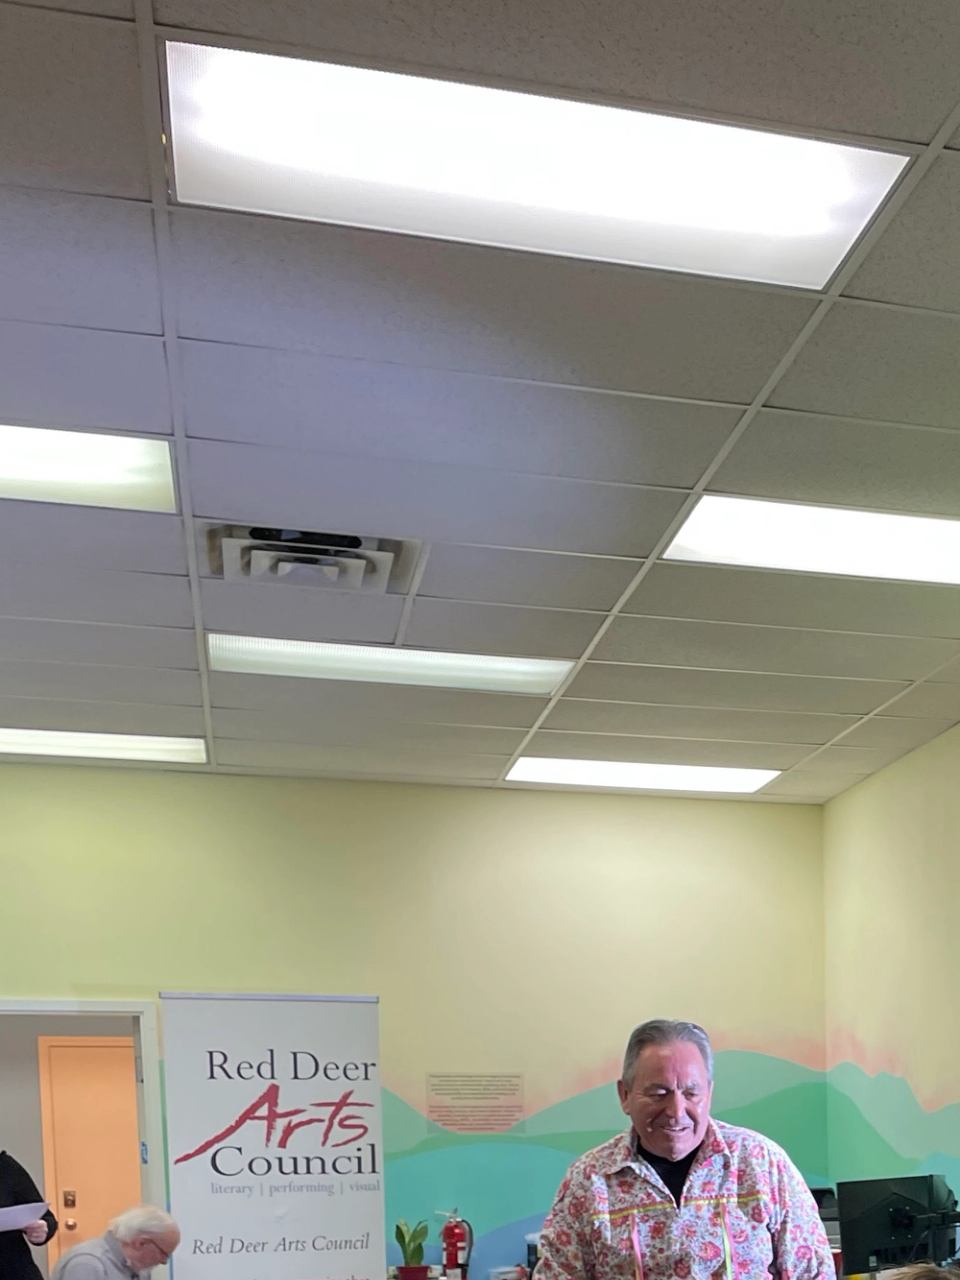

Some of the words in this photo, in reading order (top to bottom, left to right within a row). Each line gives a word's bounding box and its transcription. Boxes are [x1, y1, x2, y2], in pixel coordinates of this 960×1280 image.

[206, 1049, 277, 1081] Red
[290, 1050, 377, 1081] Deer
[174, 1083, 375, 1165] Arts
[210, 1143, 380, 1177] Council
[210, 1182, 254, 1198] literary
[269, 1180, 335, 1197] performing
[349, 1180, 380, 1192] visual
[192, 1236, 223, 1255] Red
[229, 1238, 269, 1255] Deer
[273, 1237, 307, 1252] Arts
[312, 1232, 370, 1252] Council
